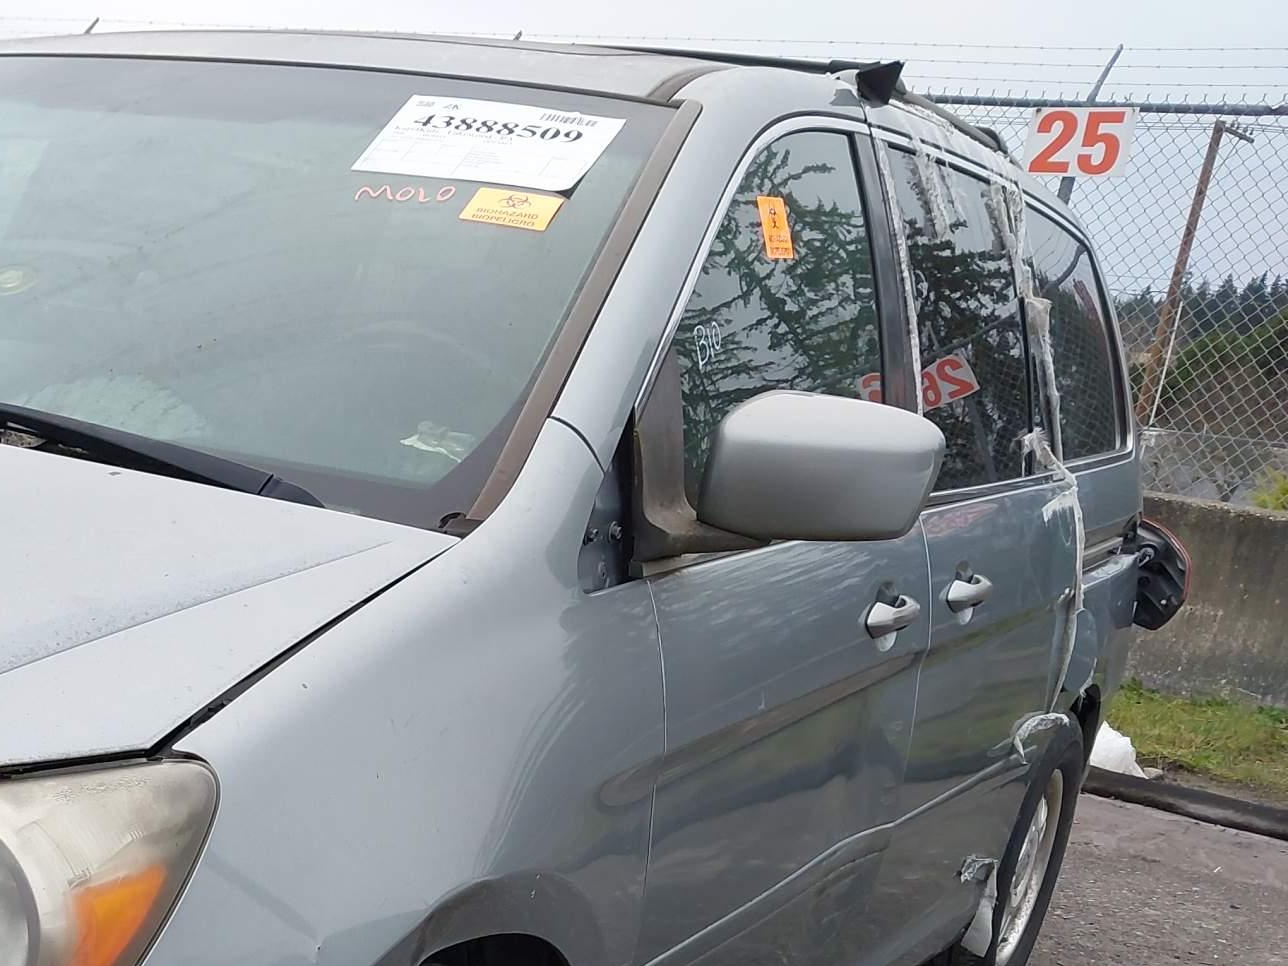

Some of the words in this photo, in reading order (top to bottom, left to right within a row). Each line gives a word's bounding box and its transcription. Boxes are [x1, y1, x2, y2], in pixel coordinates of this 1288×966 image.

[414, 113, 583, 143] 43888509
[1028, 110, 1126, 176] 25
[471, 213, 536, 227] BIOPELIGRO
[476, 207, 539, 220] BIOHAZARD
